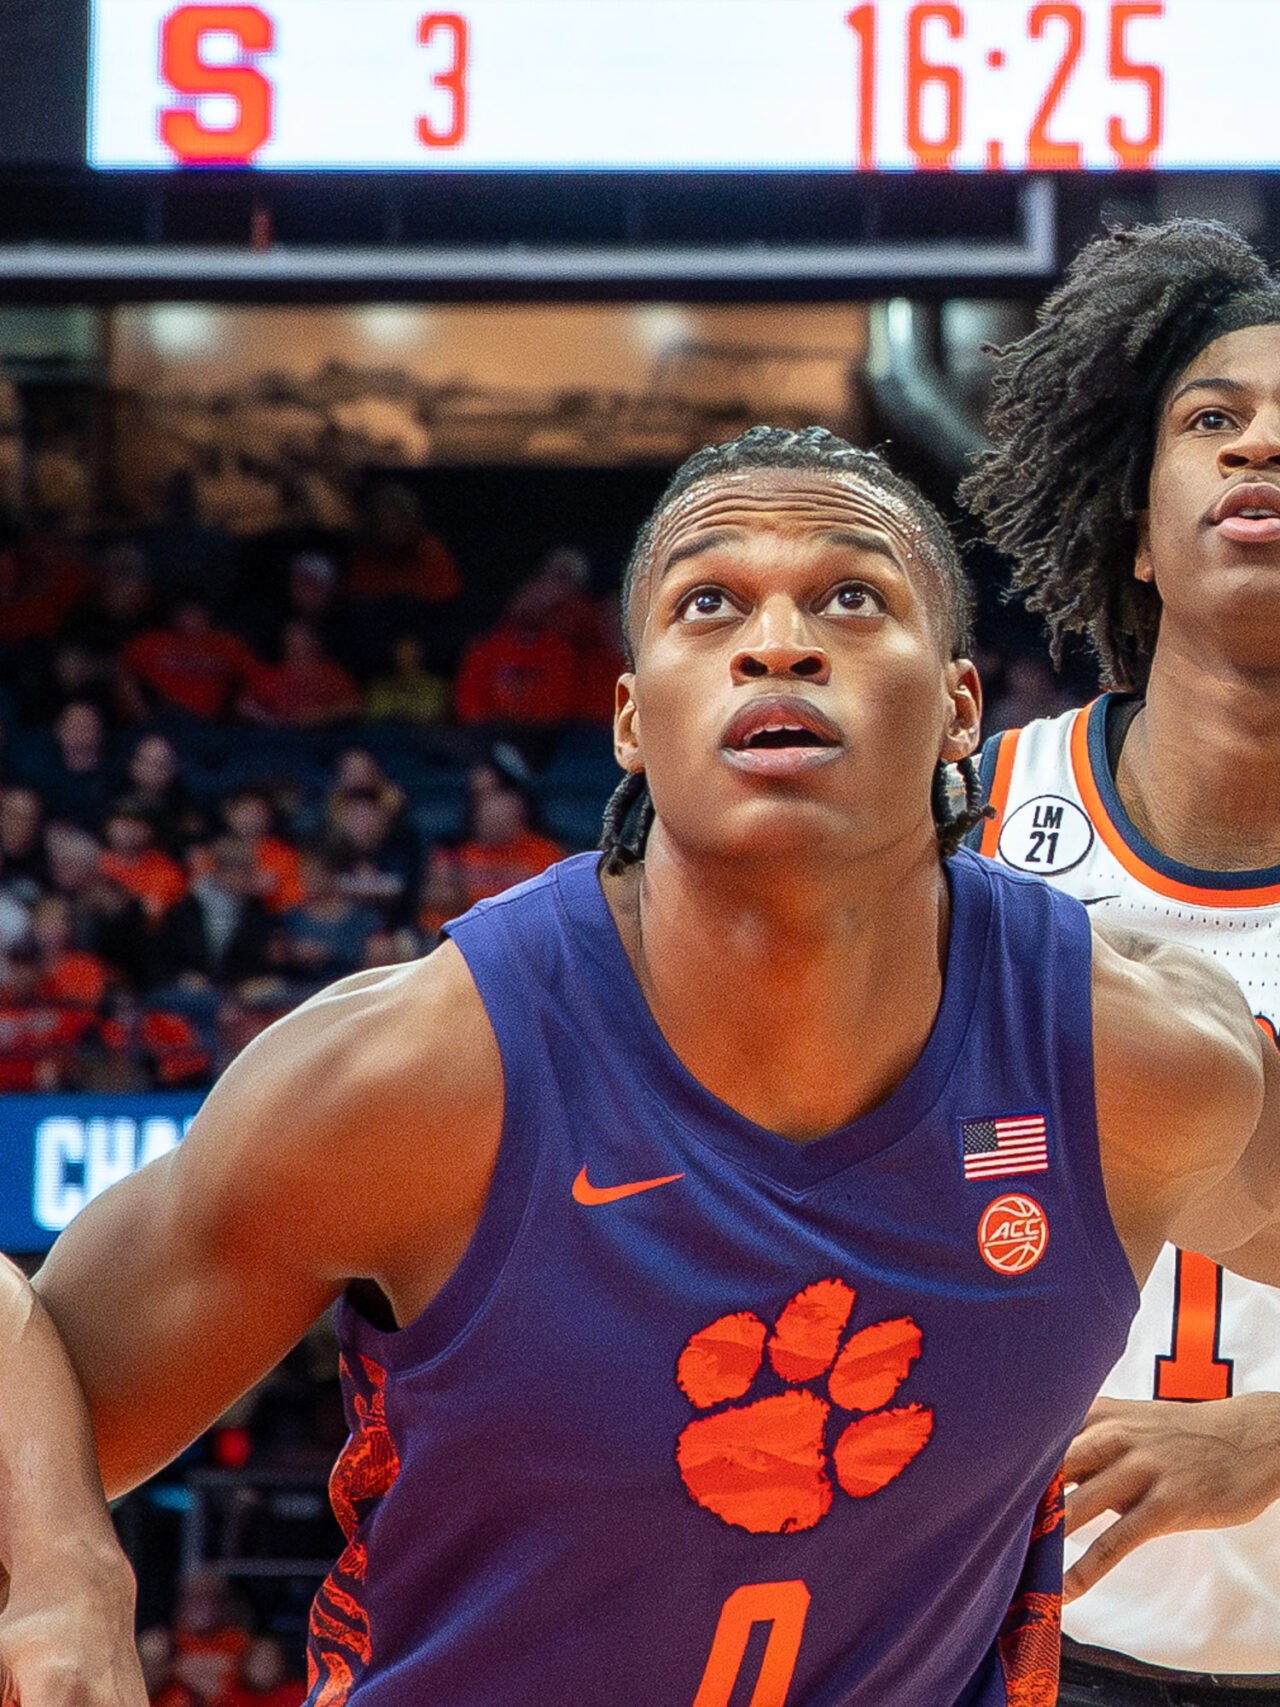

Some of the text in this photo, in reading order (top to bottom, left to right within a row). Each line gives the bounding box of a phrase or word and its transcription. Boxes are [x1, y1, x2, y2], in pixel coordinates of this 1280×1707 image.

[158, 4, 275, 167] S
[416, 13, 468, 148] 3
[843, 3, 1165, 171] 16:25
[1024, 831, 1060, 865] 21
[1032, 805, 1064, 830] LM
[989, 1217, 1043, 1242] ACC
